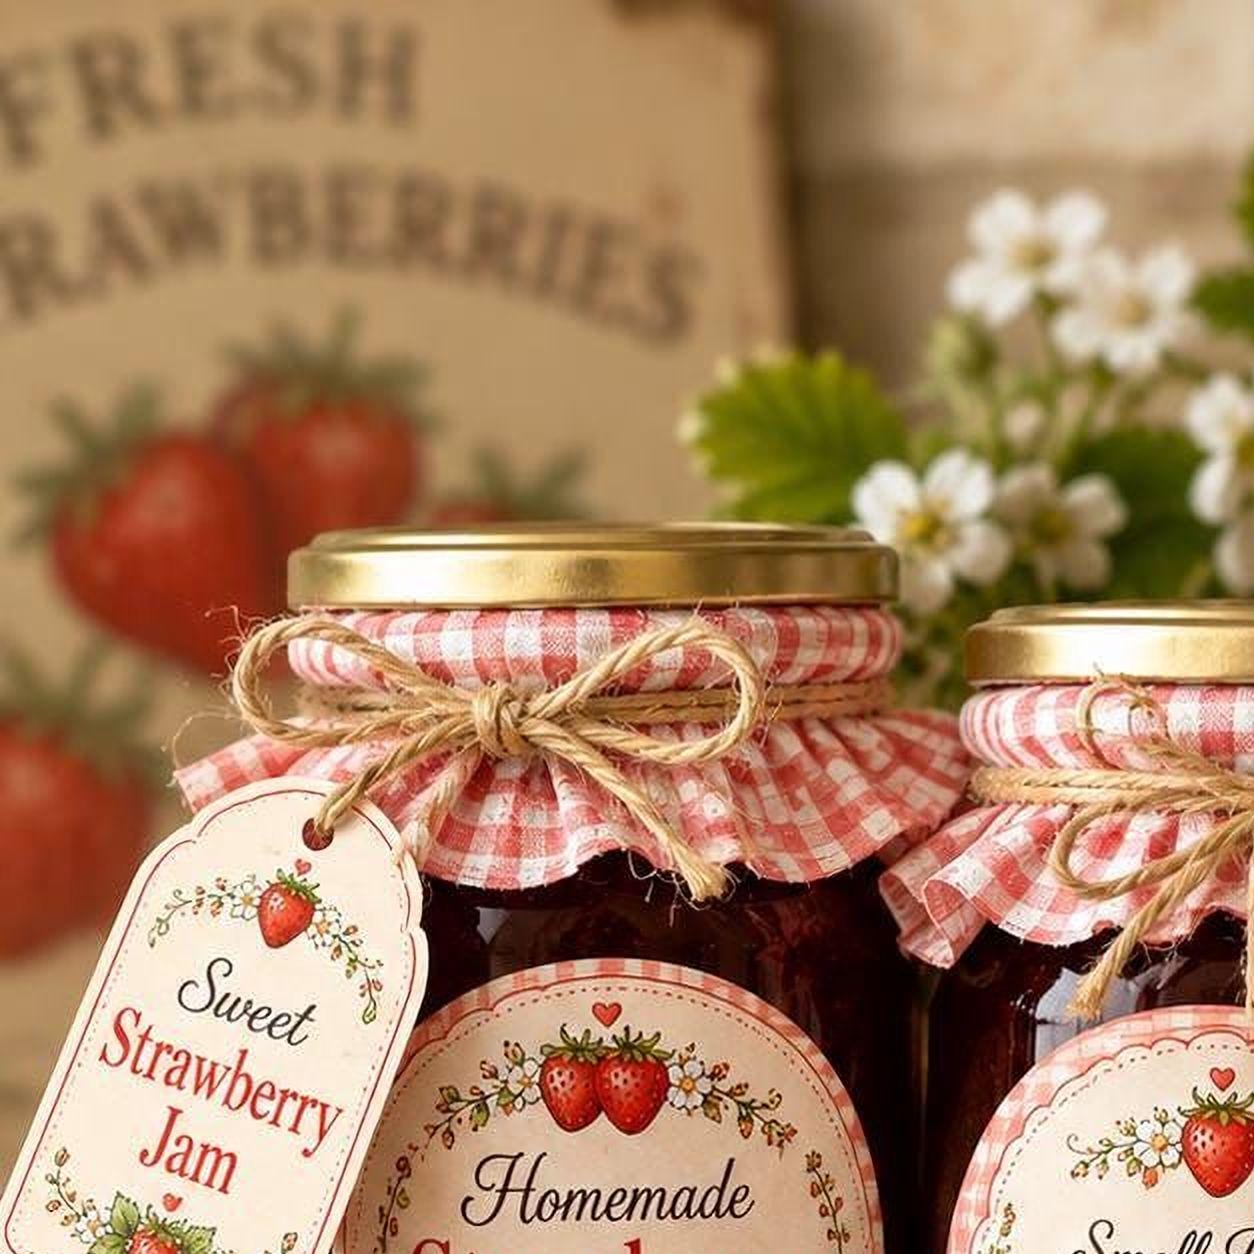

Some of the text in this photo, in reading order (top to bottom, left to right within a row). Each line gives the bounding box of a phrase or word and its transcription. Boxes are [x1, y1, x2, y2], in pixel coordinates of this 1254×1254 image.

[0, 10, 422, 168] FRESH
[177, 956, 317, 1047] Sweet
[98, 1006, 343, 1158] Strawberry
[138, 1106, 239, 1195] Jam
[460, 1152, 755, 1226] Homemade
